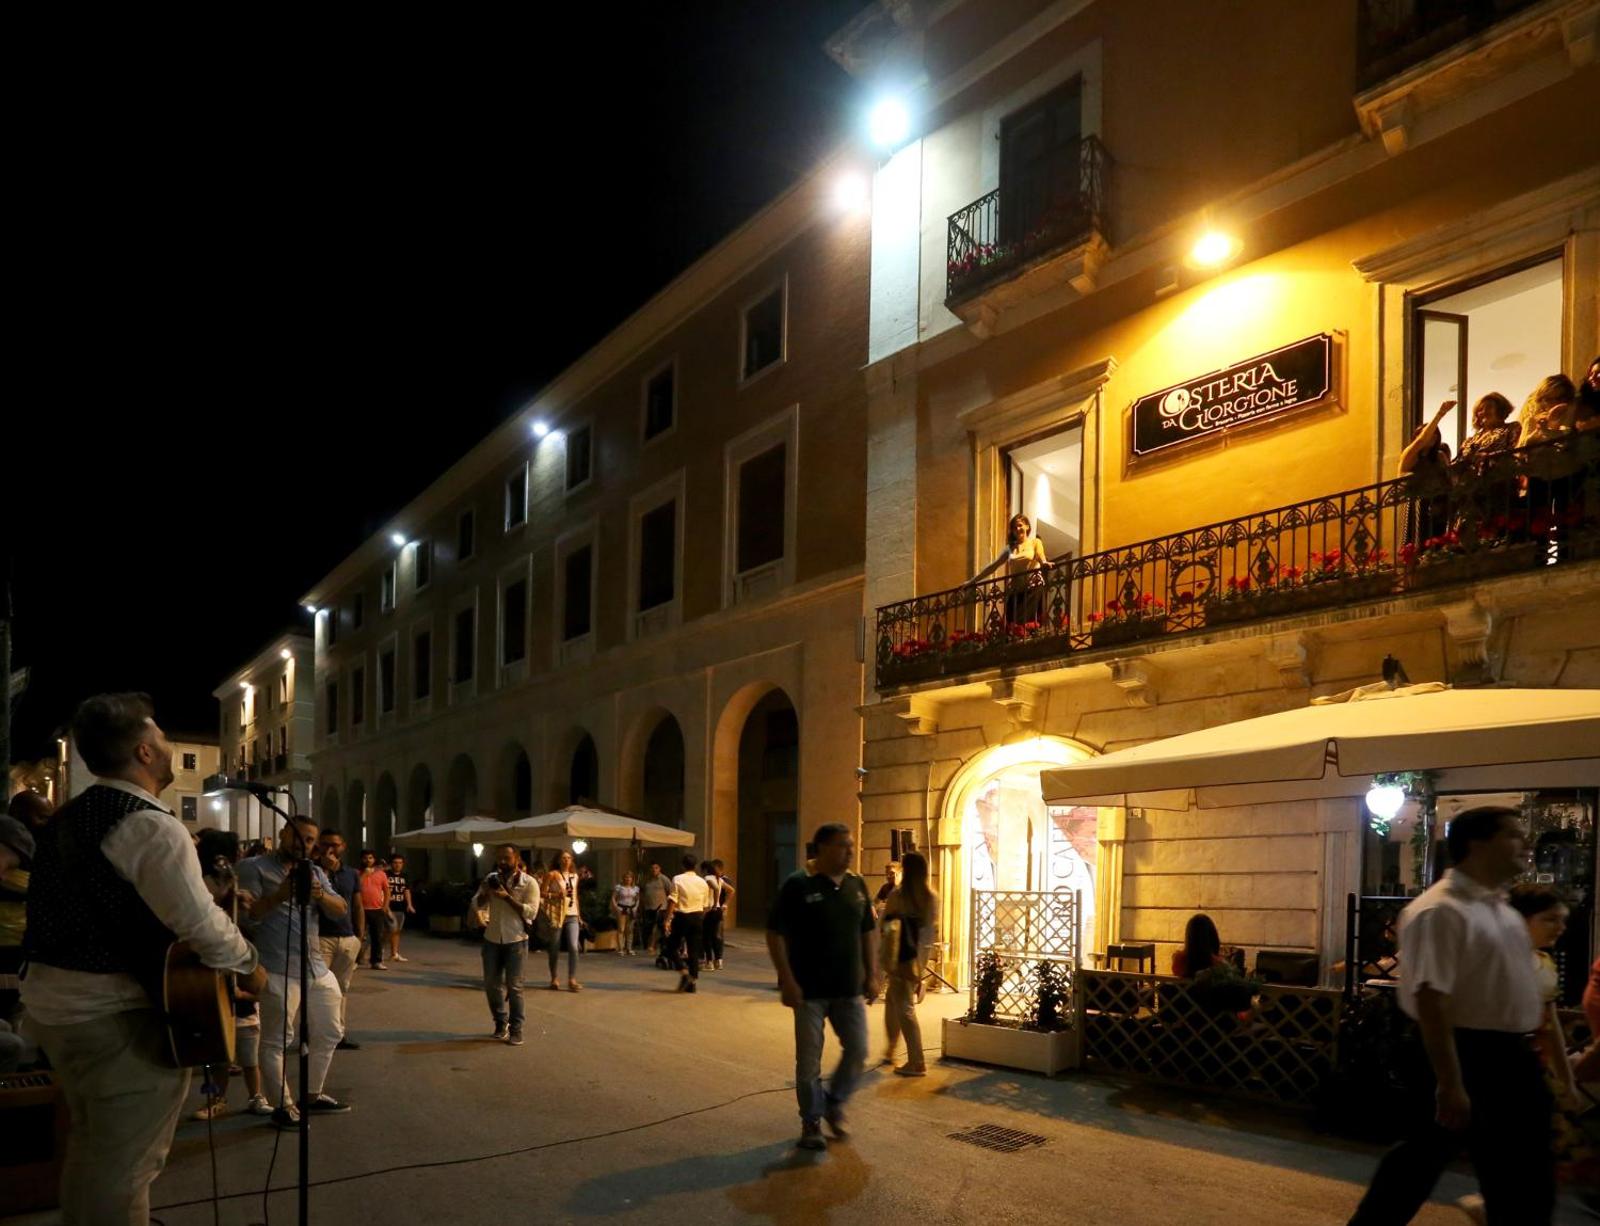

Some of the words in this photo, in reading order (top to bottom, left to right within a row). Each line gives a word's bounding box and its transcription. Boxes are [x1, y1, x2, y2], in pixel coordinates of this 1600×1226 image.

[1159, 362, 1285, 417] OSTERIA
[1162, 418, 1178, 430] DA
[1179, 379, 1298, 430] GIORGIONE
